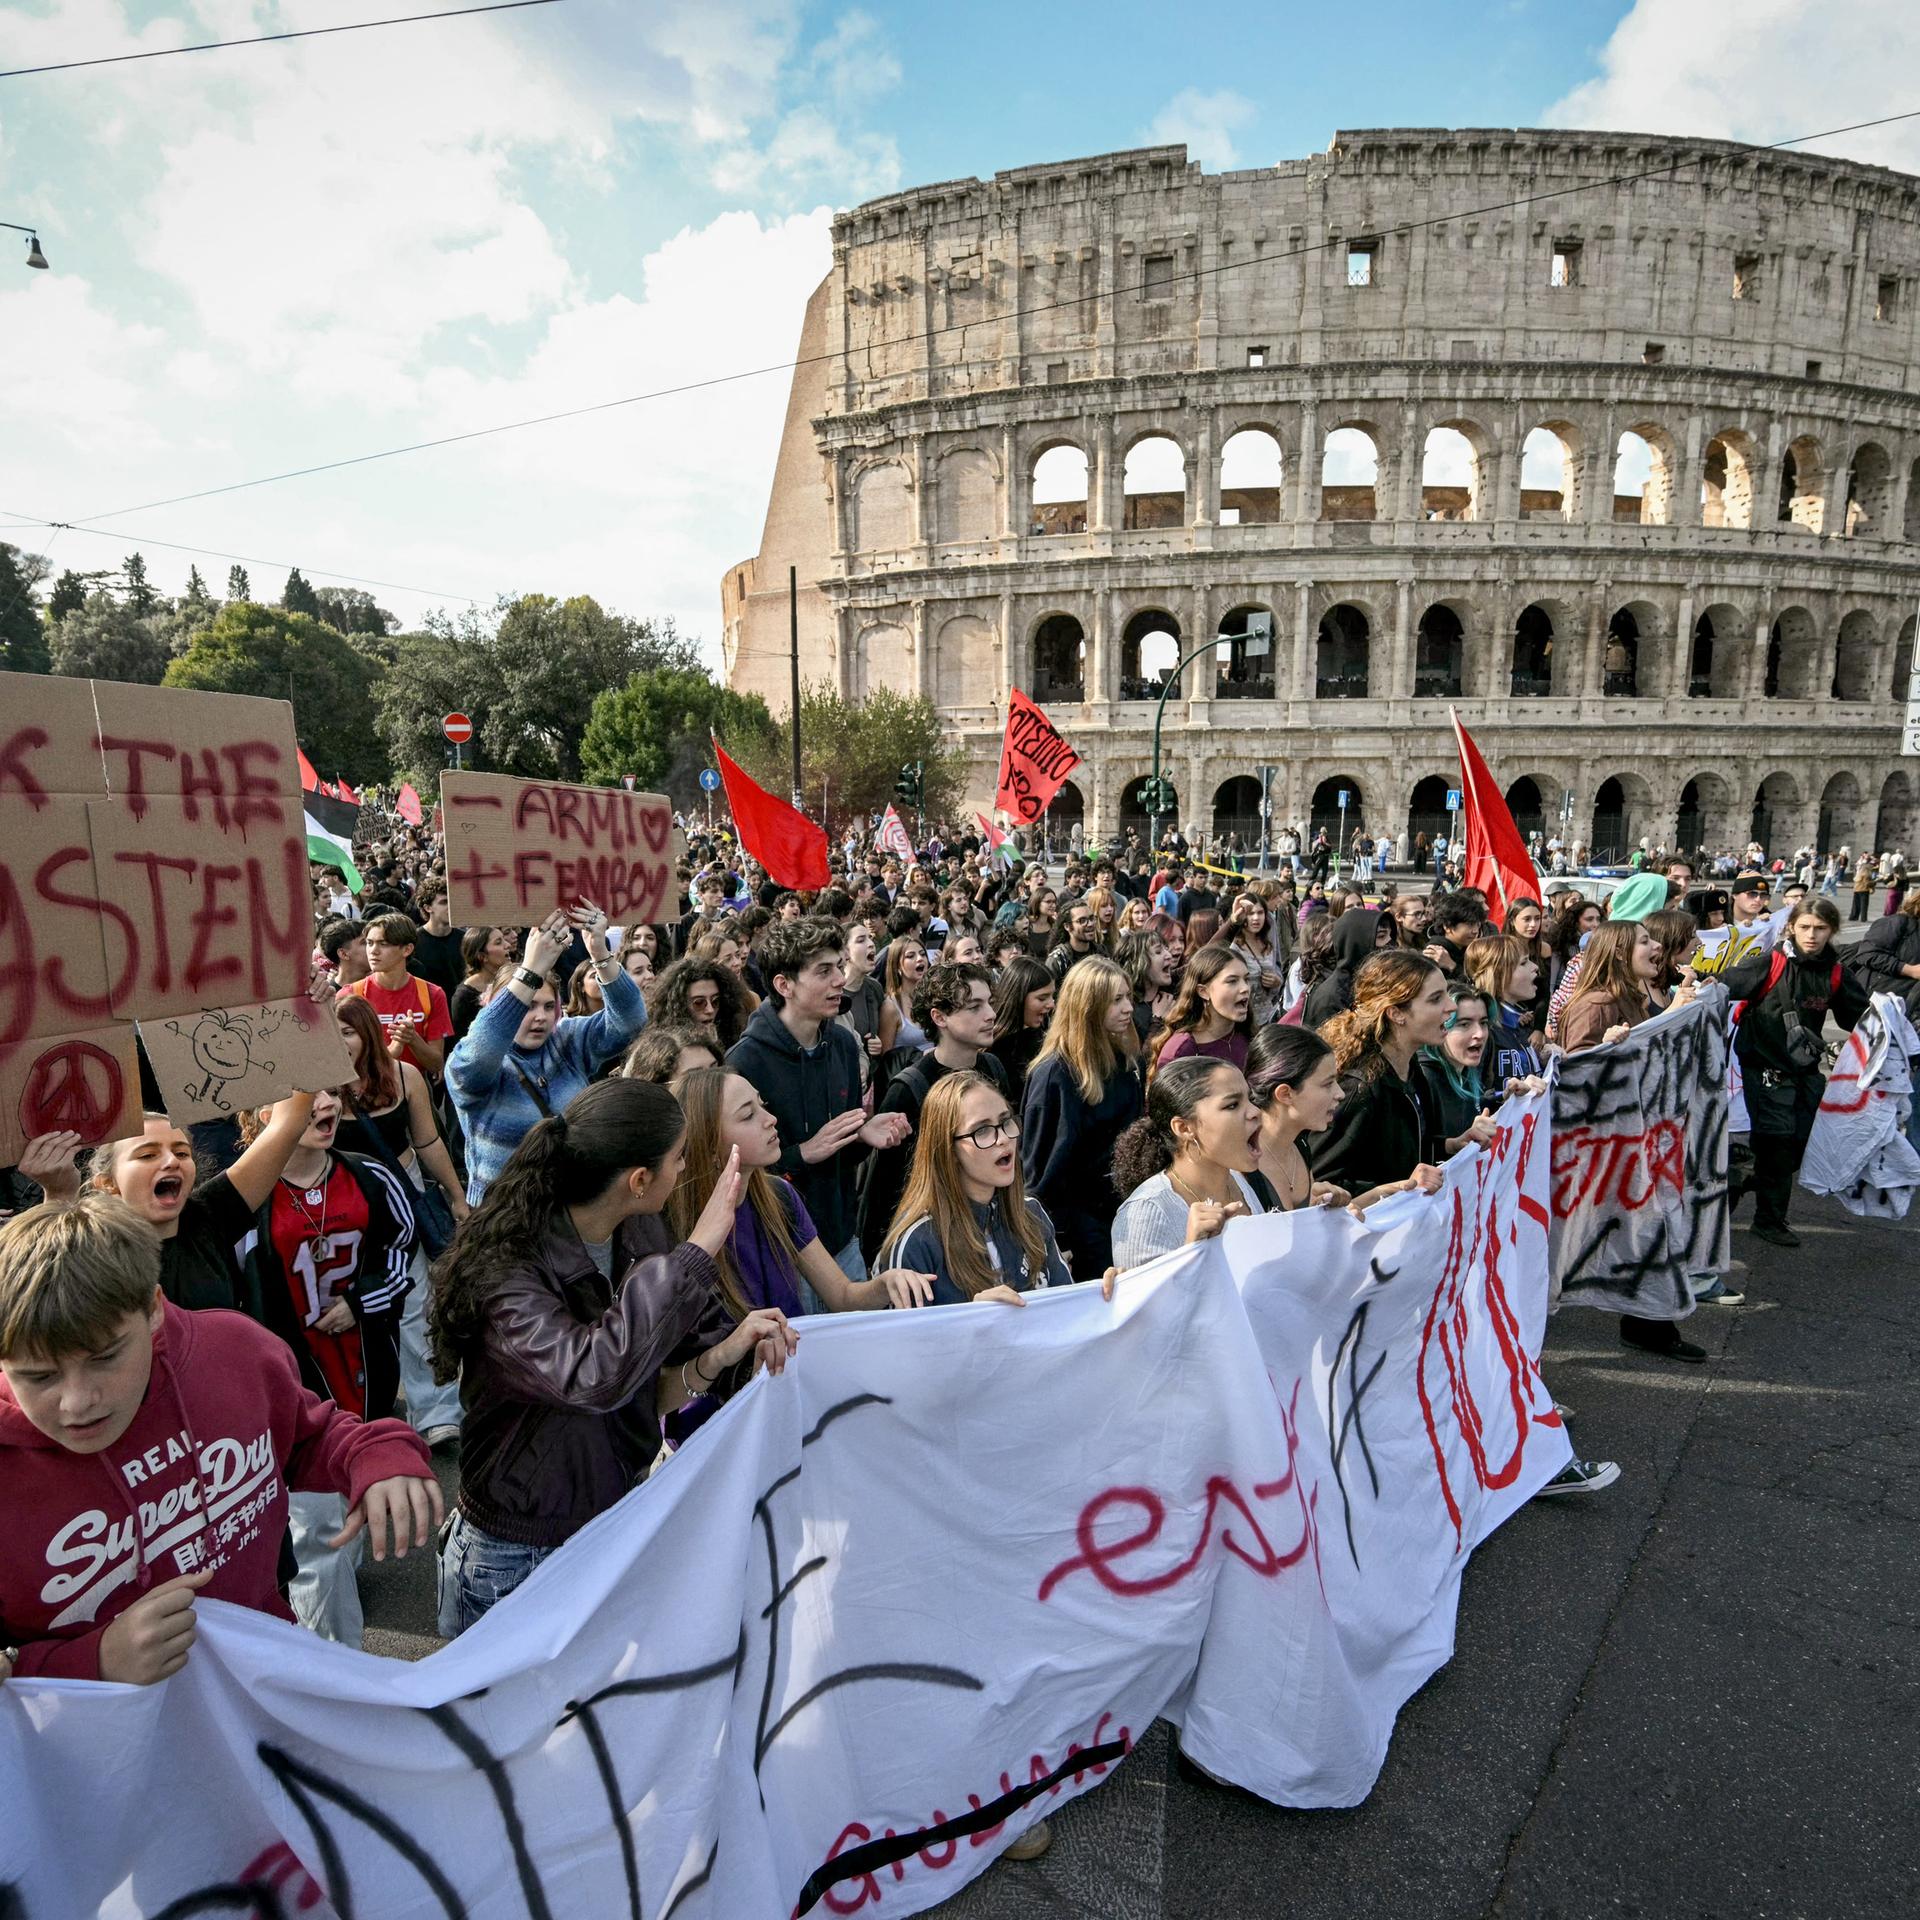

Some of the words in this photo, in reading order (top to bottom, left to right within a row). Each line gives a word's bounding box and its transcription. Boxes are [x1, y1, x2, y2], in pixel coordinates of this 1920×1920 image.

[92, 735, 284, 838] THE
[515, 785, 637, 849] ARMI
[261, 1004, 311, 1033] PIPPO
[292, 1229, 364, 1328] 12
[121, 1429, 202, 1488] REAL
